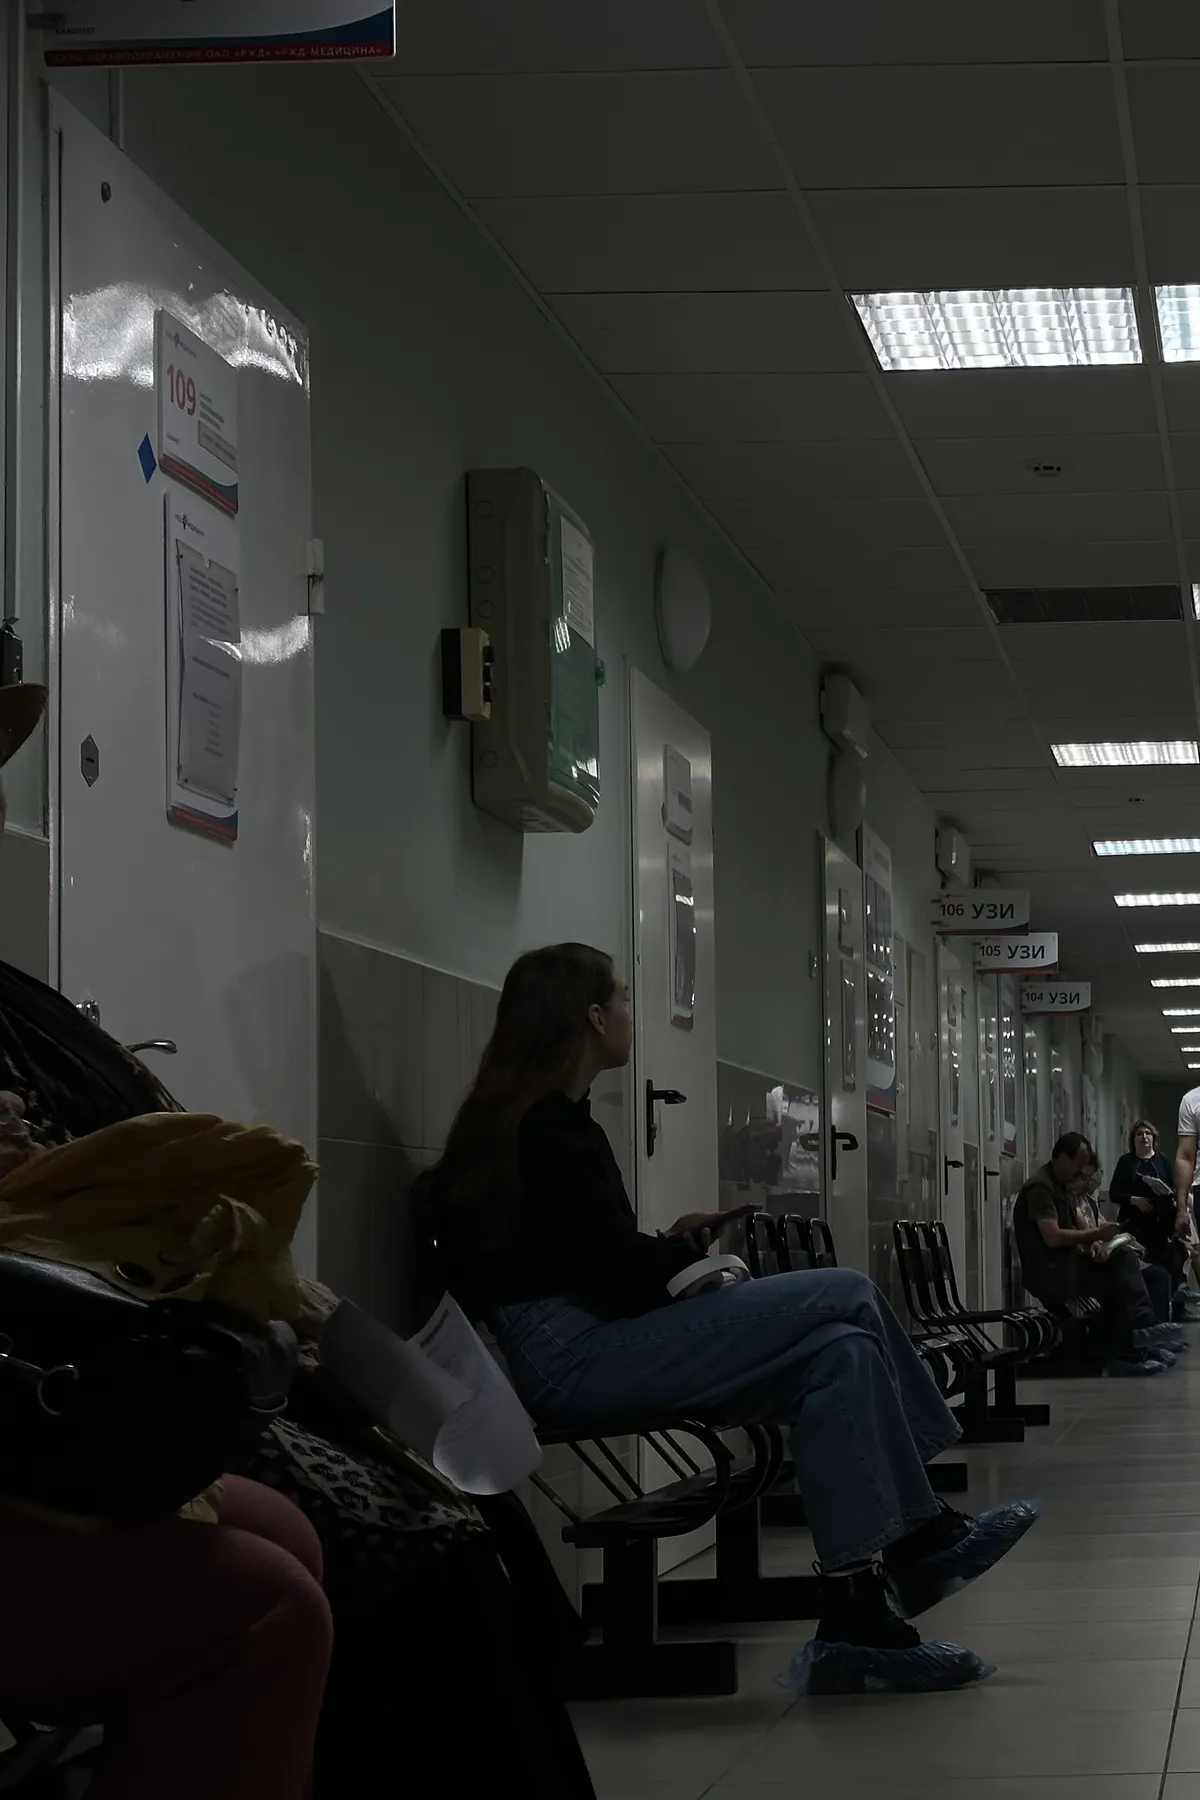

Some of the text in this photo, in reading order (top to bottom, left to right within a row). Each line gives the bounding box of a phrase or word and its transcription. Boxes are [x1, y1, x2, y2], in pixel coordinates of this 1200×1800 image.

[205, 49, 230, 58] ОАО
[166, 364, 197, 416] 109
[939, 903, 1015, 919] 106 УЗИ
[979, 945, 1045, 959] 105 УЗИ
[1025, 992, 1080, 1004] 104 УЗИ
